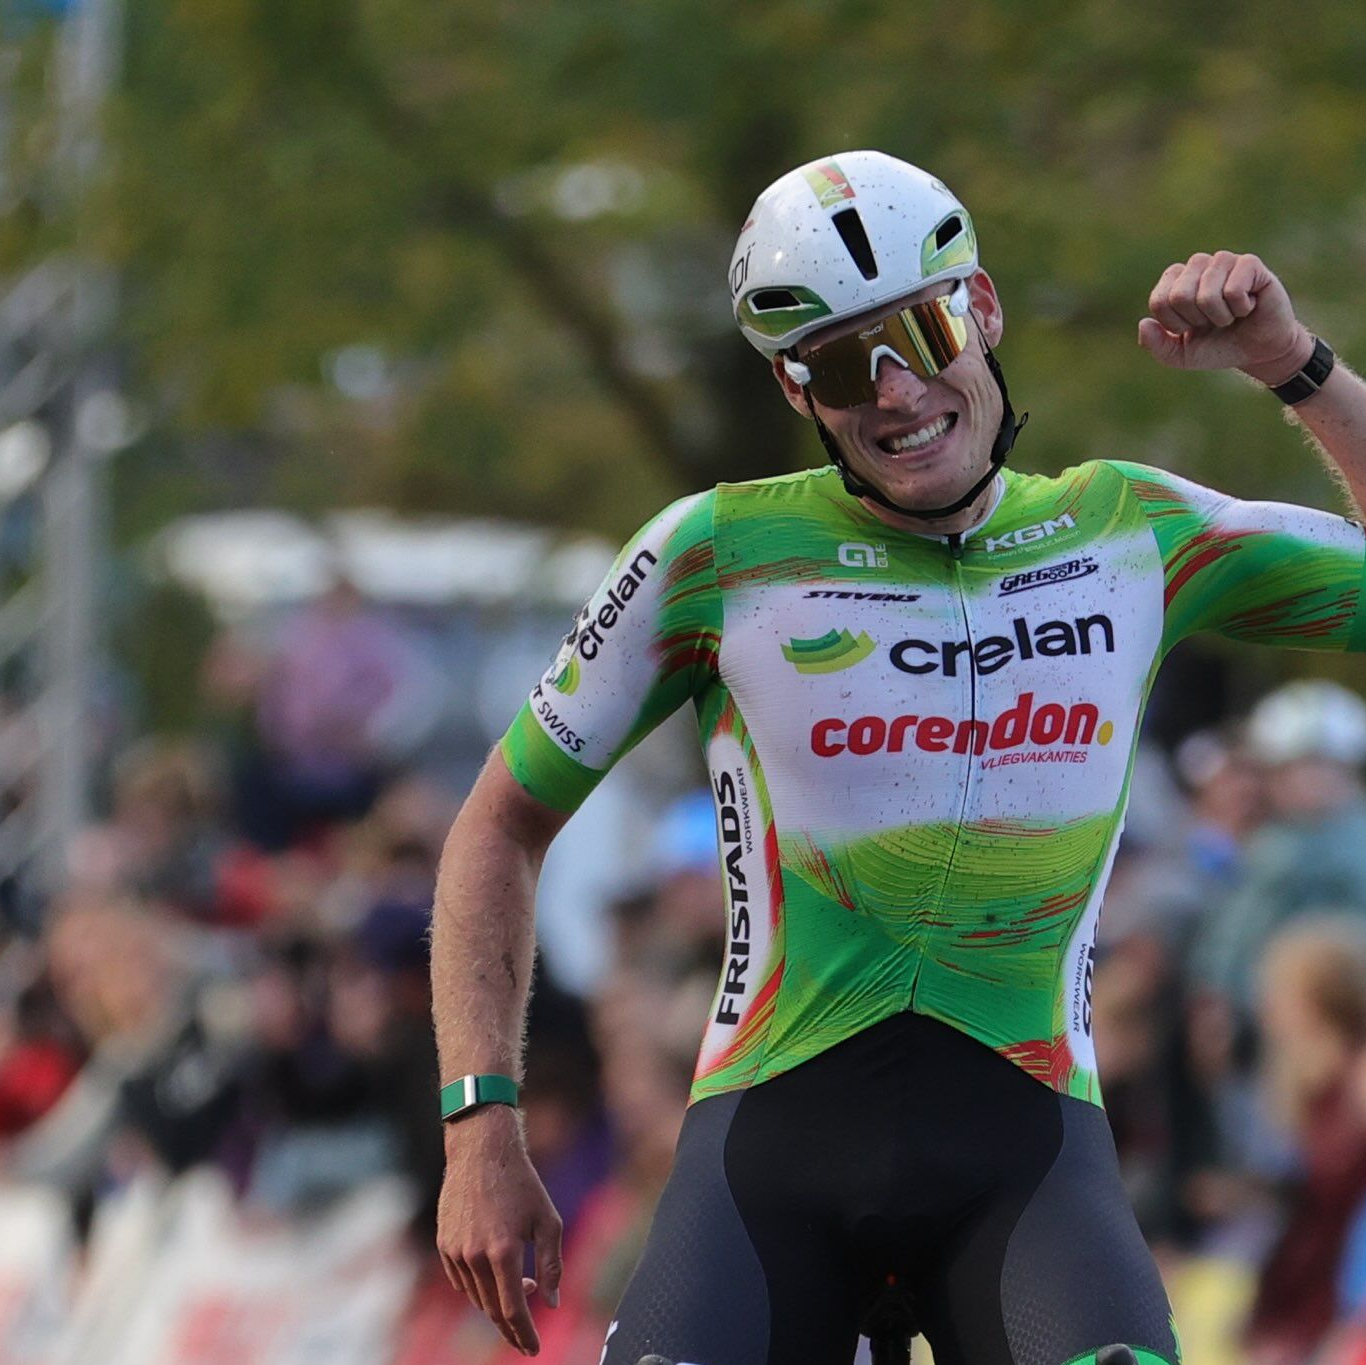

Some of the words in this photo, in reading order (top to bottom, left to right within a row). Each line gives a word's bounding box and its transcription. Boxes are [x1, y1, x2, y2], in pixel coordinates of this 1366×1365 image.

[985, 512, 1076, 553] KGM
[579, 549, 658, 661] crelan
[802, 590, 922, 602] STEVENS
[889, 613, 1115, 678] crelan
[537, 701, 587, 753] SWISS
[981, 751, 1088, 770] VLIEGVAKANTIES
[736, 767, 753, 855] WORKWEAR
[714, 770, 751, 1026] FRISTADS
[1072, 943, 1088, 1033] WORKWEAR
